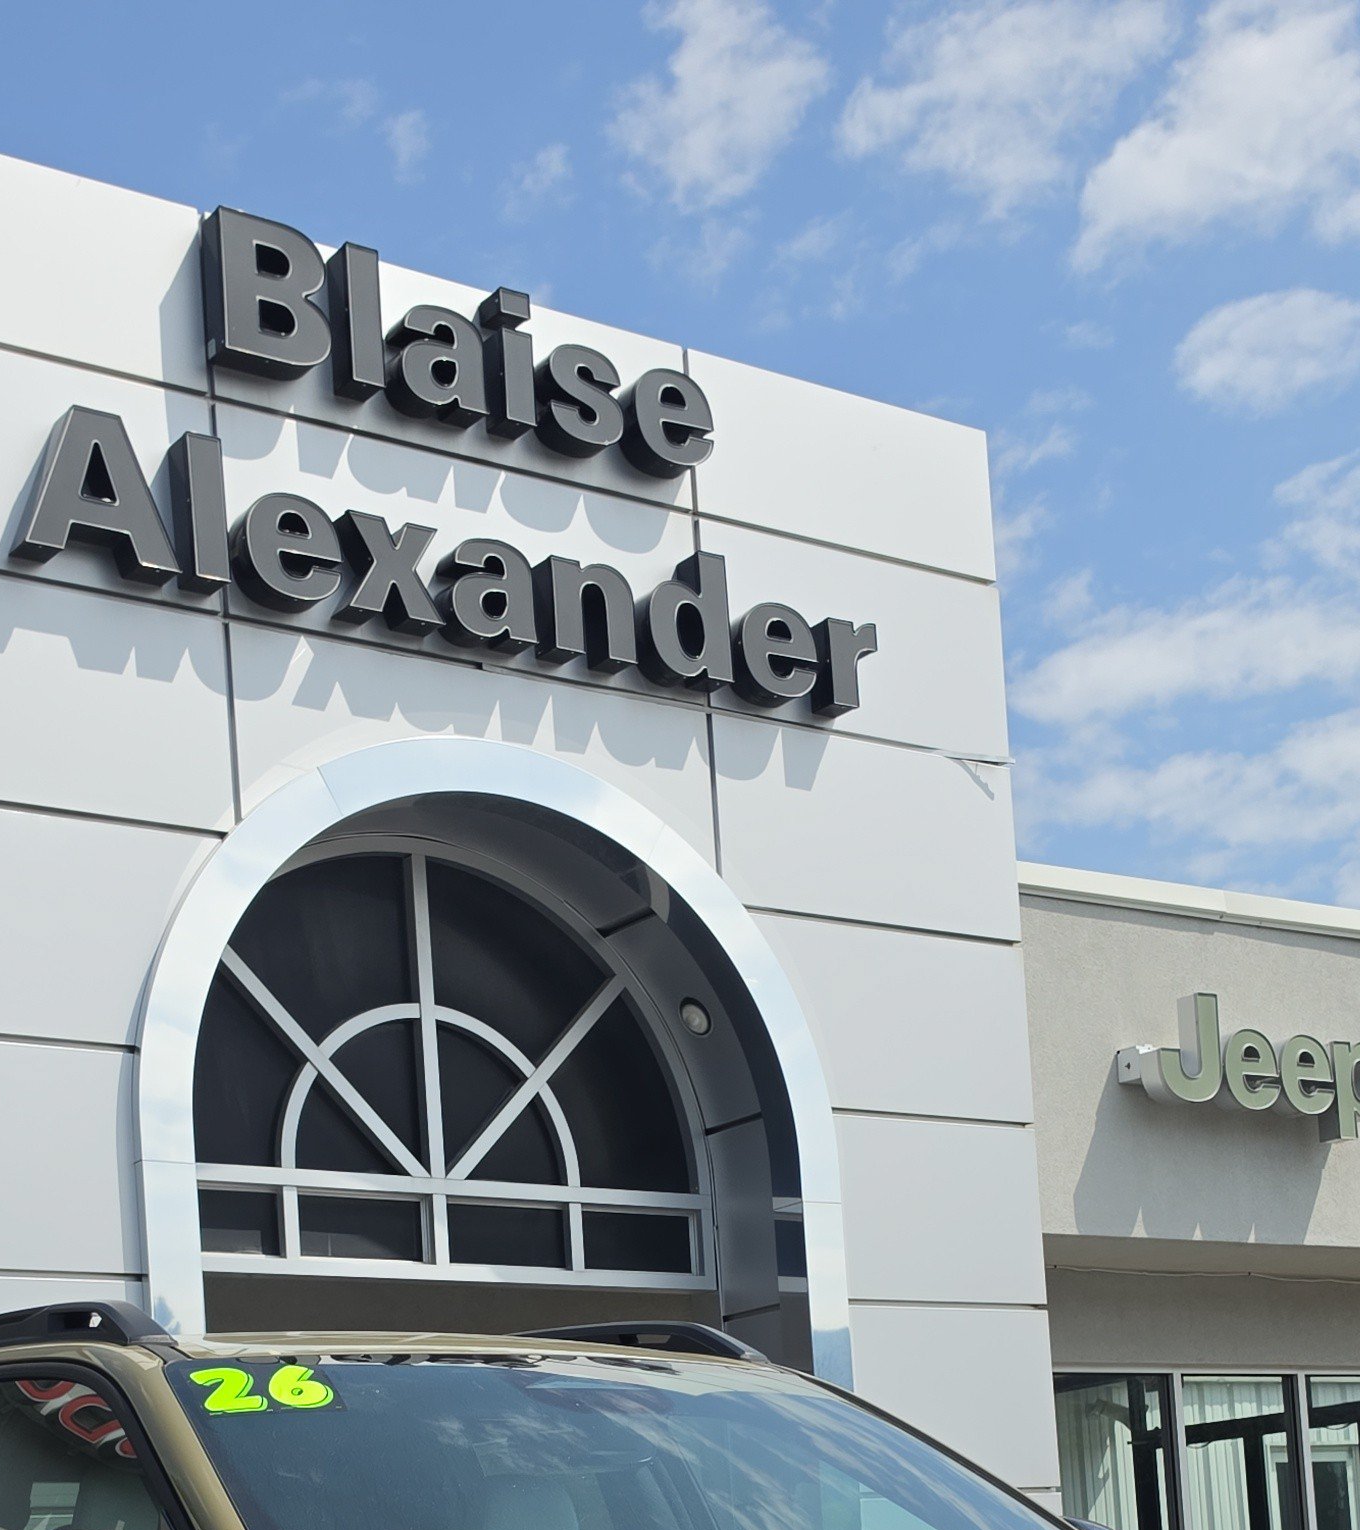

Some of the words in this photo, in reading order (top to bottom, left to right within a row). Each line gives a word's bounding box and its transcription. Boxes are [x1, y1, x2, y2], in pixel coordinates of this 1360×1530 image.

[200, 205, 716, 480] Blaise
[10, 404, 878, 719] Alexander
[189, 1365, 335, 1414] 26
